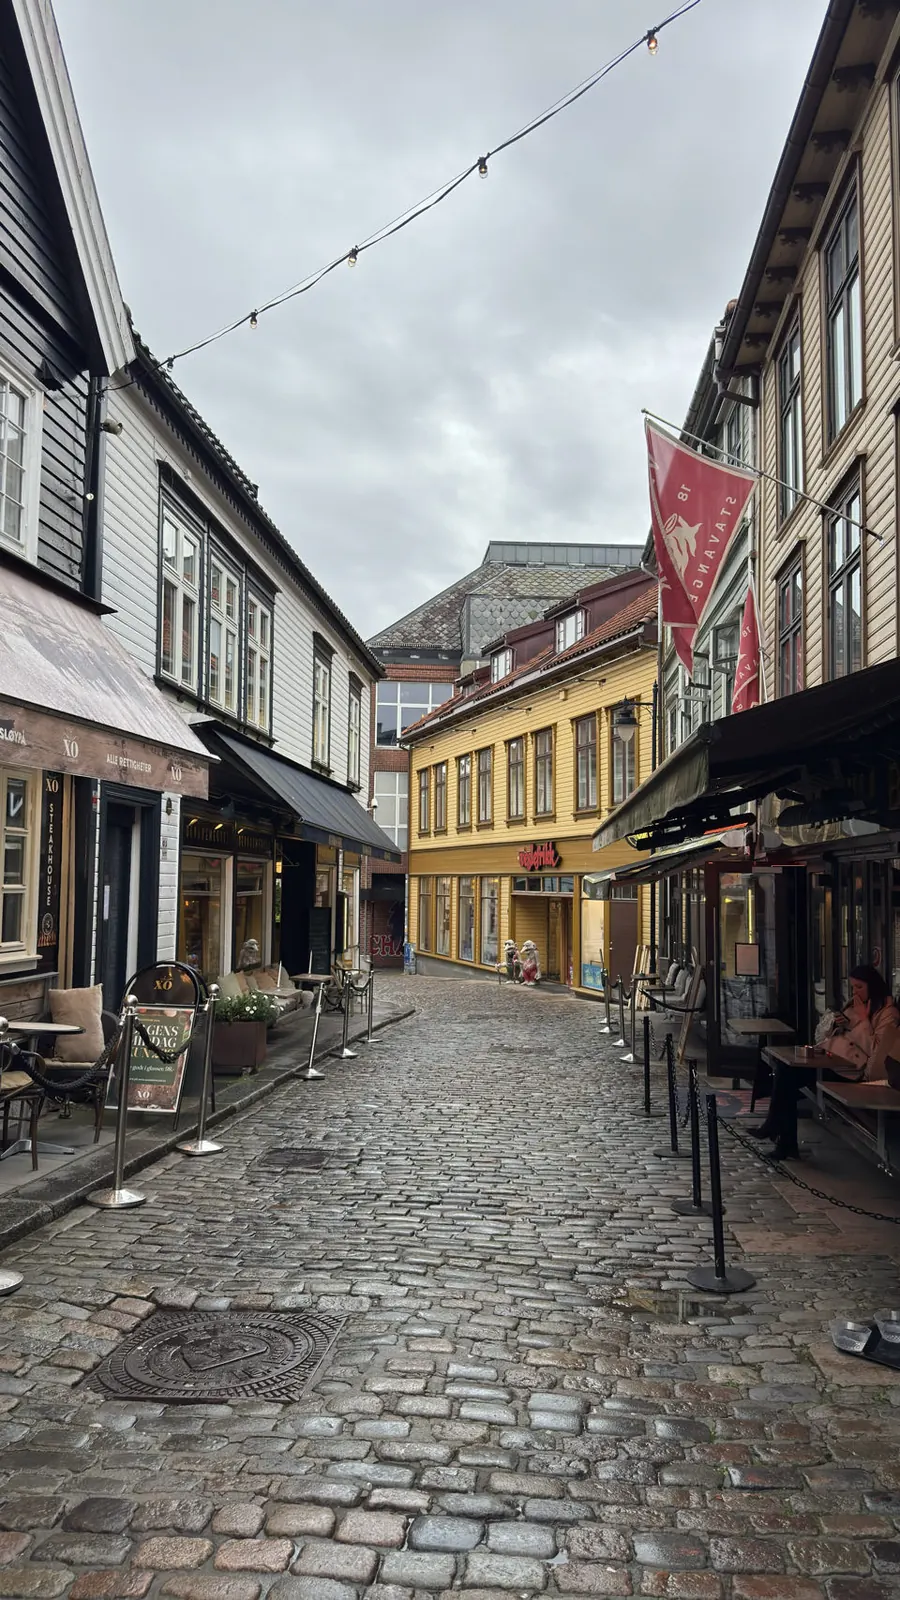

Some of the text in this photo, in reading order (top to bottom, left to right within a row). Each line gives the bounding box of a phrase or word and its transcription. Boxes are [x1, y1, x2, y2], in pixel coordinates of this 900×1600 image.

[62, 738, 79, 758] XO
[106, 753, 118, 766] ALLE
[170, 765, 182, 782] XO
[45, 778, 59, 793] XO
[46, 804, 54, 906] STEAKHOUSE
[153, 979, 173, 990] XO
[137, 1090, 150, 1099] XO
